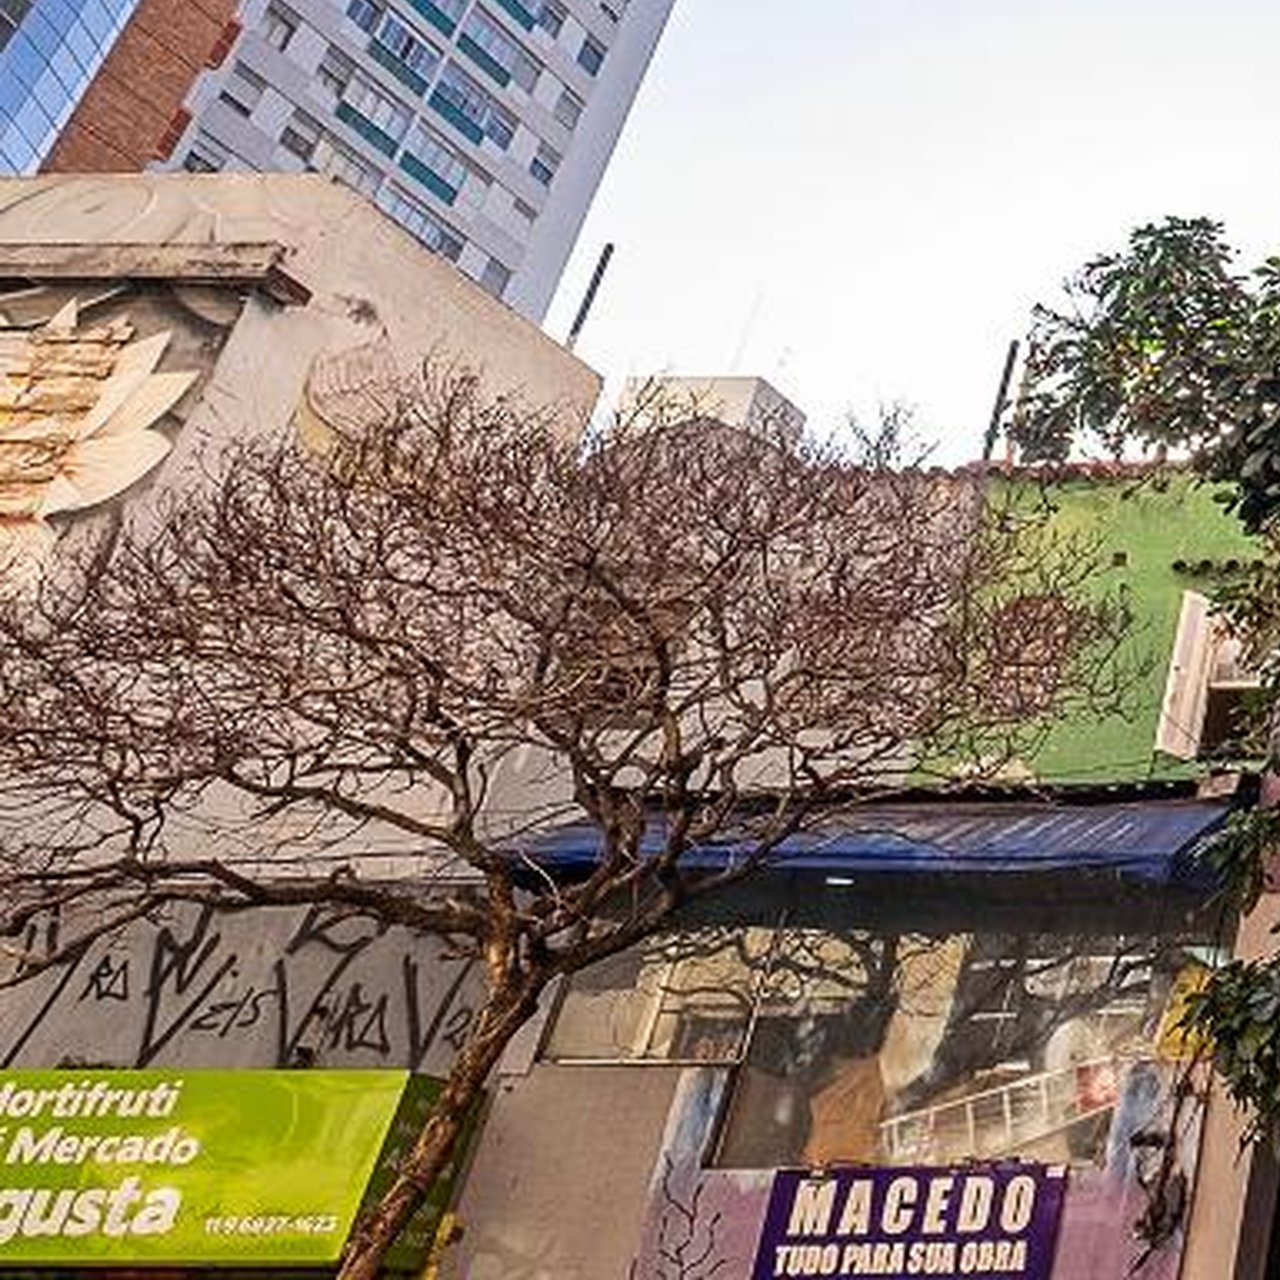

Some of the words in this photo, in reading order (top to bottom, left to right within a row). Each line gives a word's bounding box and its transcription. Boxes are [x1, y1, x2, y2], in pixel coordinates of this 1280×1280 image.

[5, 1126, 202, 1165] Mercado
[785, 1175, 1037, 1237] MACEDO
[772, 1243, 841, 1277] TUDO
[840, 1242, 905, 1275] PARA
[906, 1241, 957, 1274] SUA
[958, 1239, 1028, 1271] OBRA
